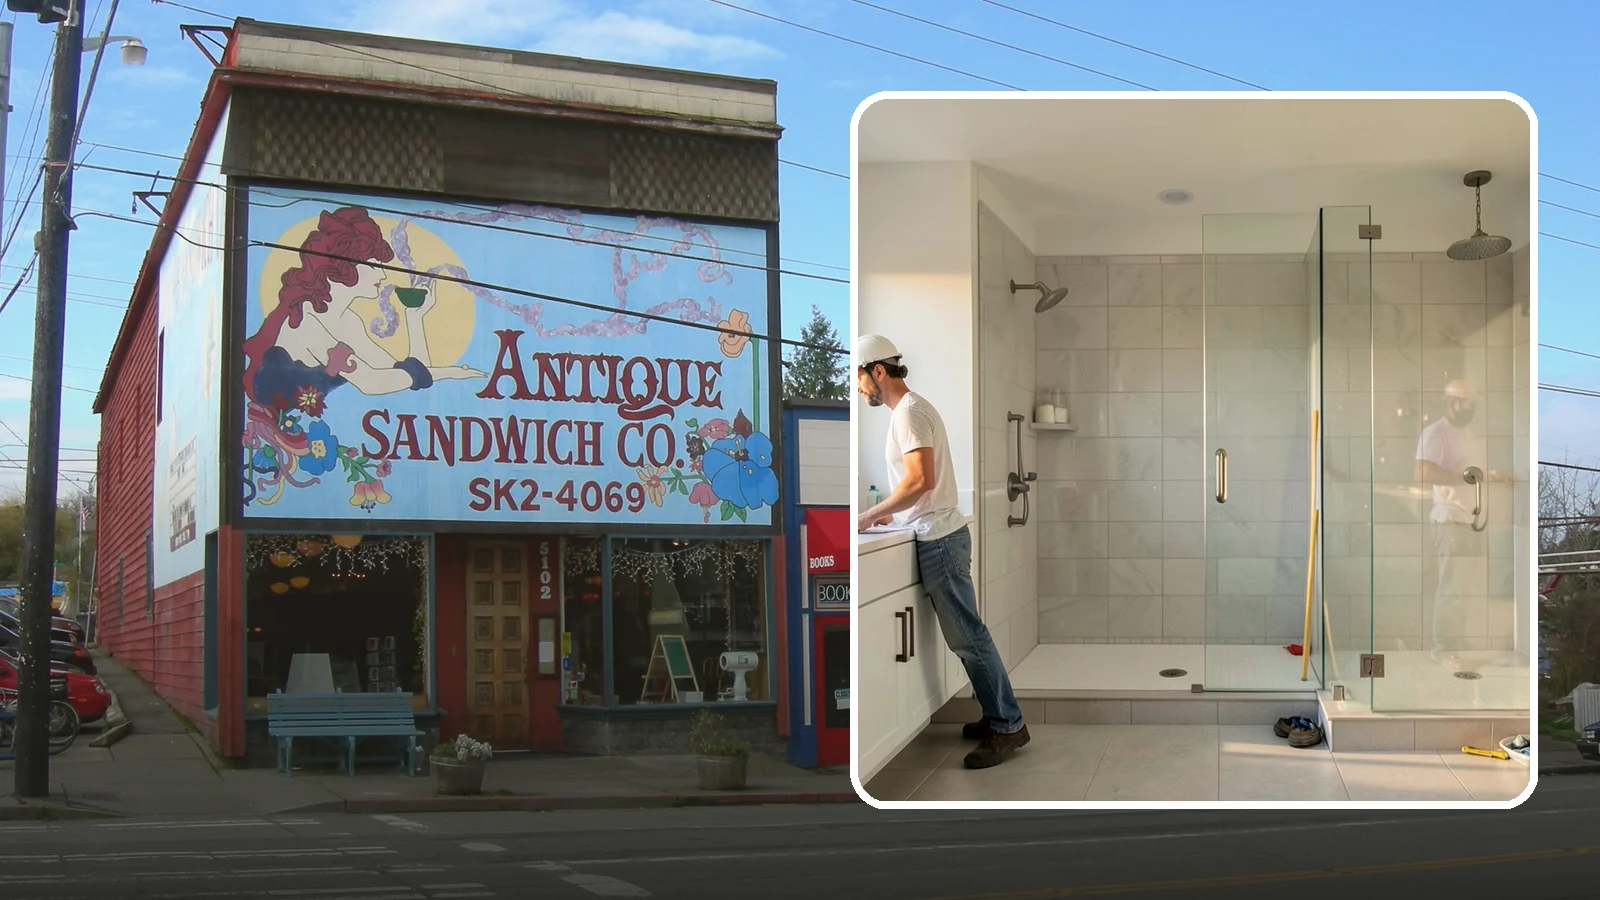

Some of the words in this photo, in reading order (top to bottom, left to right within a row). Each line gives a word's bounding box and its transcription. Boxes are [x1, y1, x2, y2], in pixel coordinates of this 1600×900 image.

[475, 328, 723, 420] ANTIQUE
[361, 408, 604, 467] SANDWICH
[617, 422, 685, 469] CO.
[468, 476, 646, 513] SK2-4069
[540, 541, 551, 600] 5102
[809, 555, 835, 569] BOOKS
